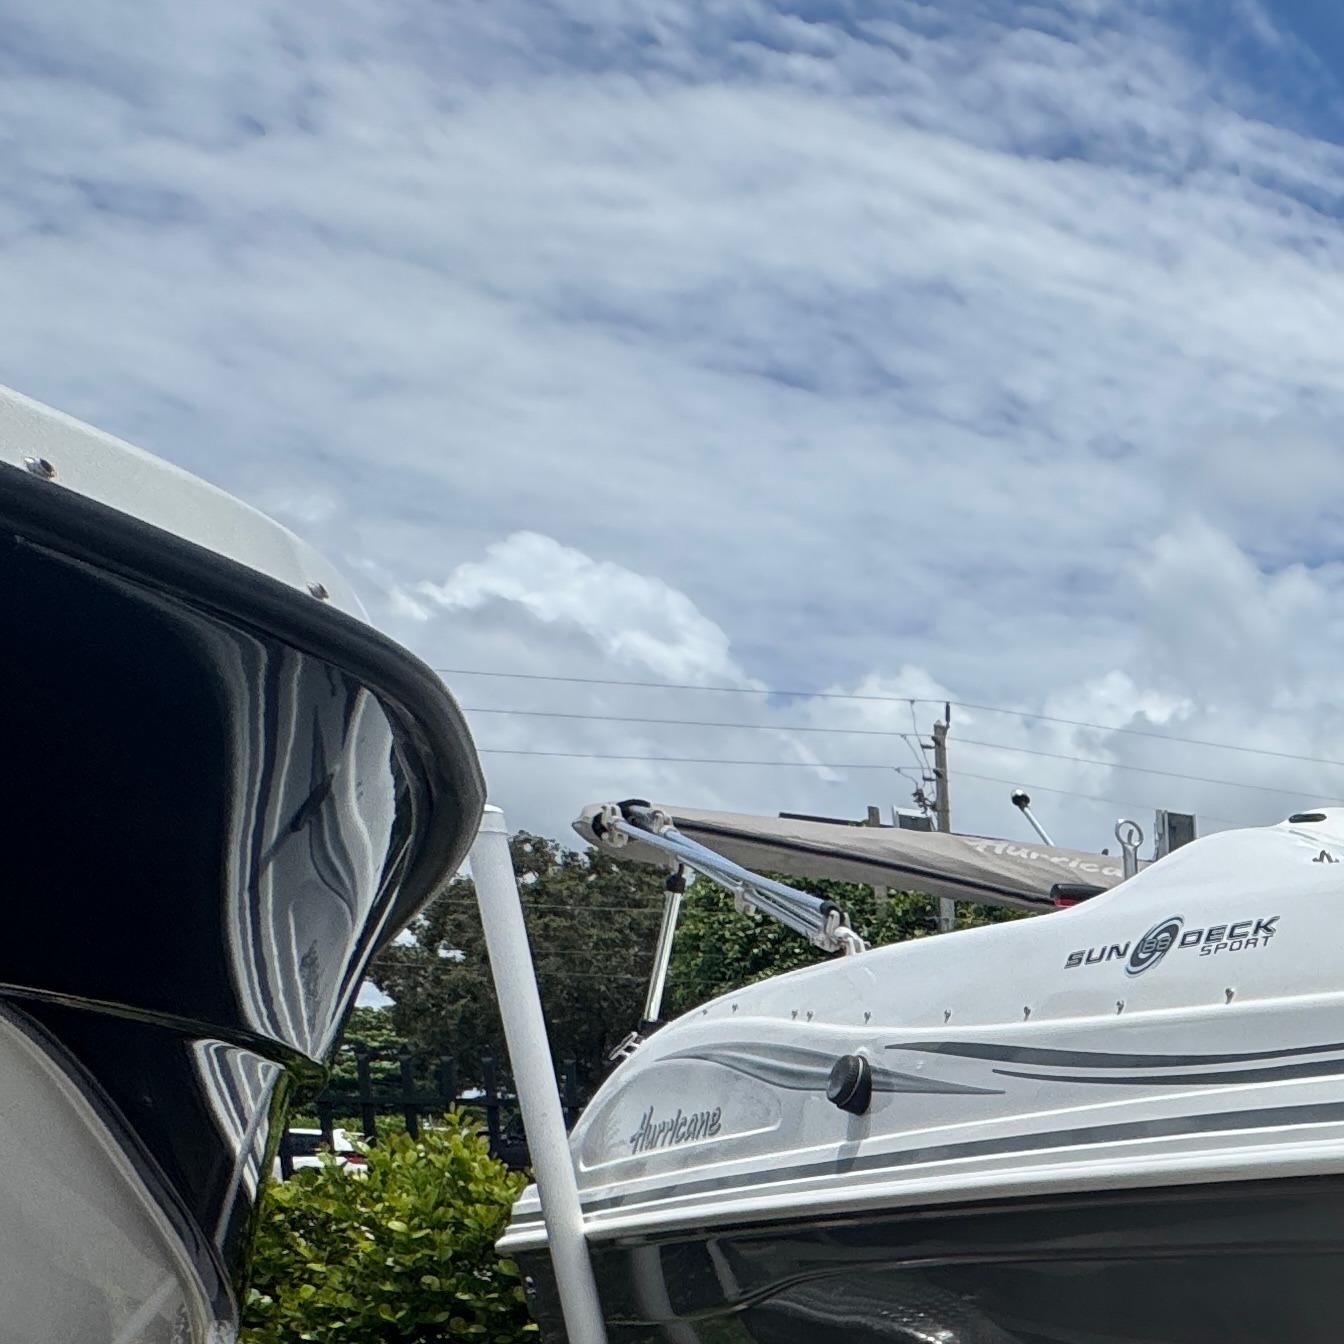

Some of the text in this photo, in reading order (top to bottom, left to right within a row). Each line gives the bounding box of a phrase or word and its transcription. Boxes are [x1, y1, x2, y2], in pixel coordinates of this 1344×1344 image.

[960, 837, 1123, 878] Hurrica
[1064, 941, 1131, 969] SUN
[1178, 916, 1280, 949] DECK
[1200, 936, 1273, 956] SPORT
[630, 1105, 721, 1155] Hurricane
